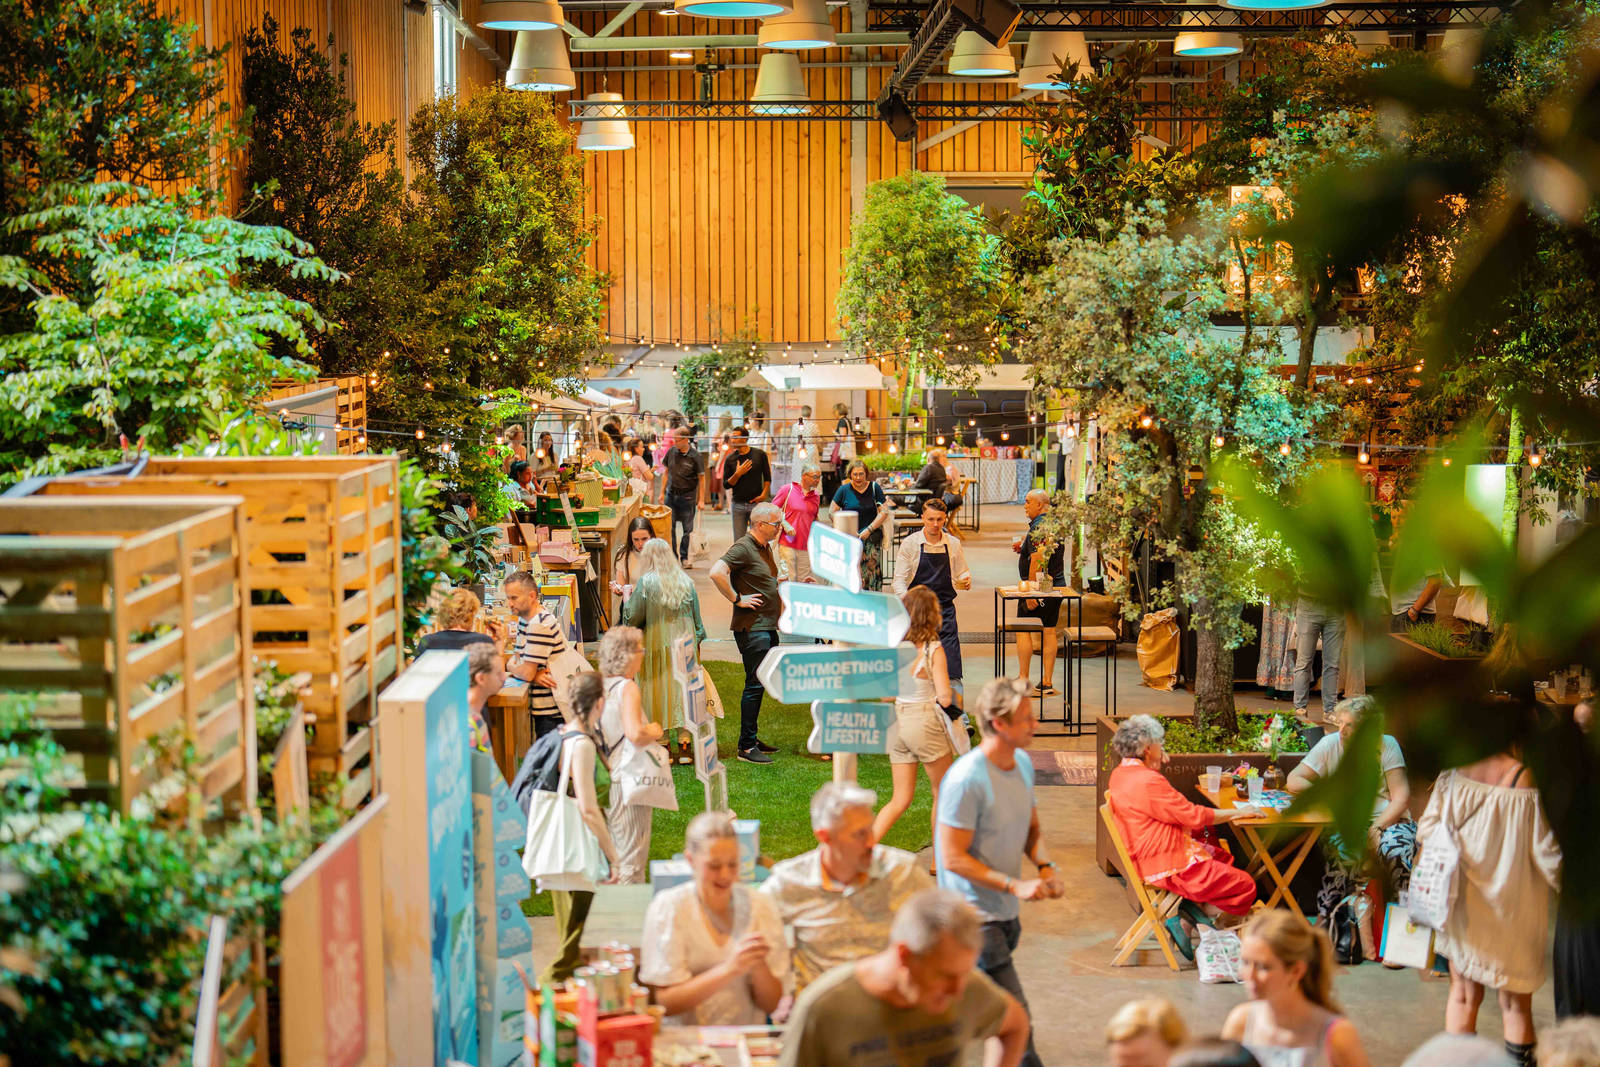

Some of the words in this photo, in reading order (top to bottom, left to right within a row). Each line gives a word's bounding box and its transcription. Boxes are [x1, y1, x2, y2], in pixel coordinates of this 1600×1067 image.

[793, 601, 875, 626] TOILETTEN
[786, 660, 894, 677] ONTMOETINGS
[786, 676, 843, 691] RUIMTE
[826, 712, 868, 728] HEALTH
[824, 728, 880, 744] LIFESTYLE
